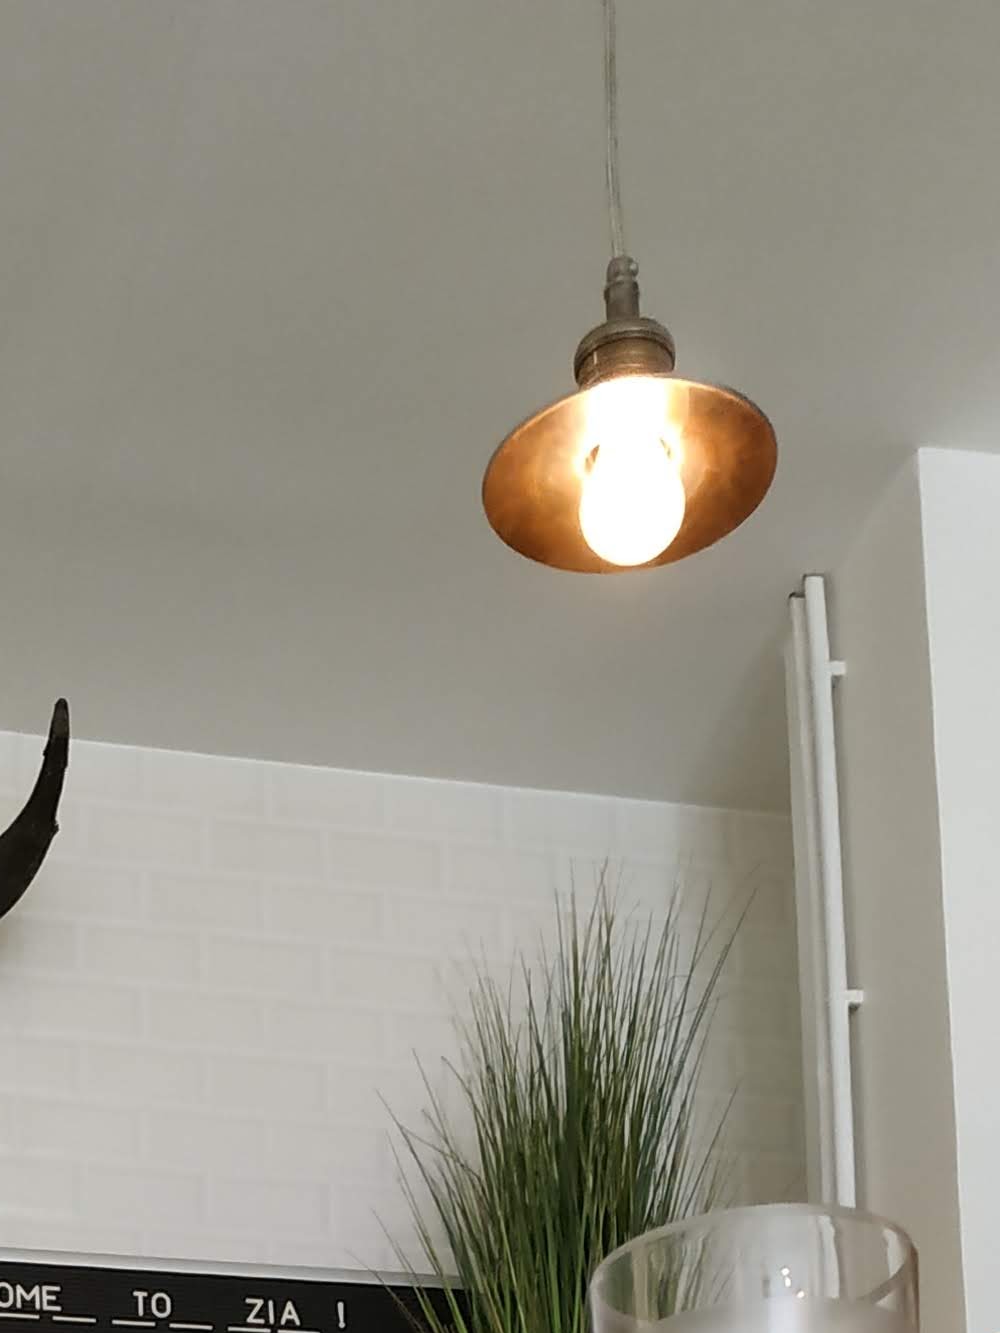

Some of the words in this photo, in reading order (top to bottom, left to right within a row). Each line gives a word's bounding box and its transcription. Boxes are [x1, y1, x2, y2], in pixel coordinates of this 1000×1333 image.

[133, 1291, 172, 1318] TO
[245, 1298, 301, 1326] ZIA
[337, 1301, 346, 1328] !
